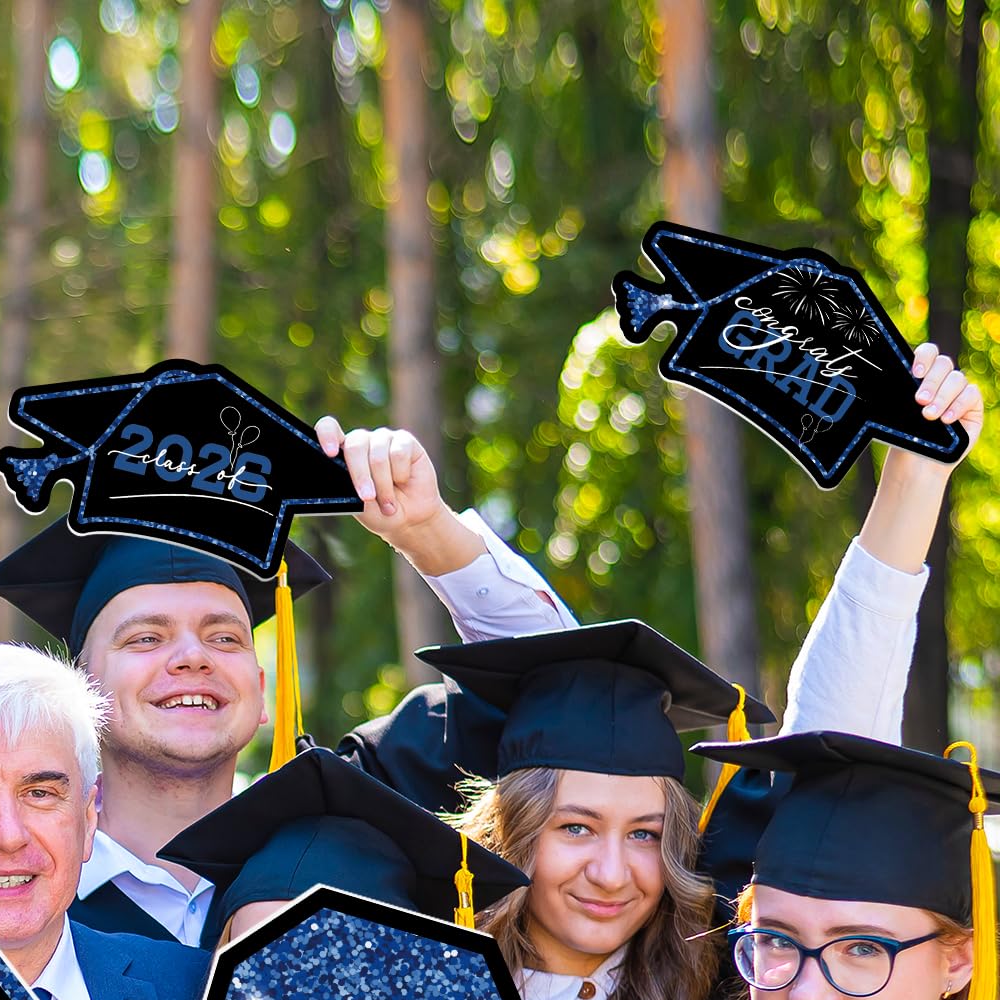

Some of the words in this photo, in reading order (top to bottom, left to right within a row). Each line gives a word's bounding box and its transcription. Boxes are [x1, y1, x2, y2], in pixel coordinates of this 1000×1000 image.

[718, 311, 857, 423] GRAD
[722, 296, 883, 378] congrats
[107, 449, 201, 476] class
[216, 466, 273, 490] of
[113, 424, 272, 502] 2026
